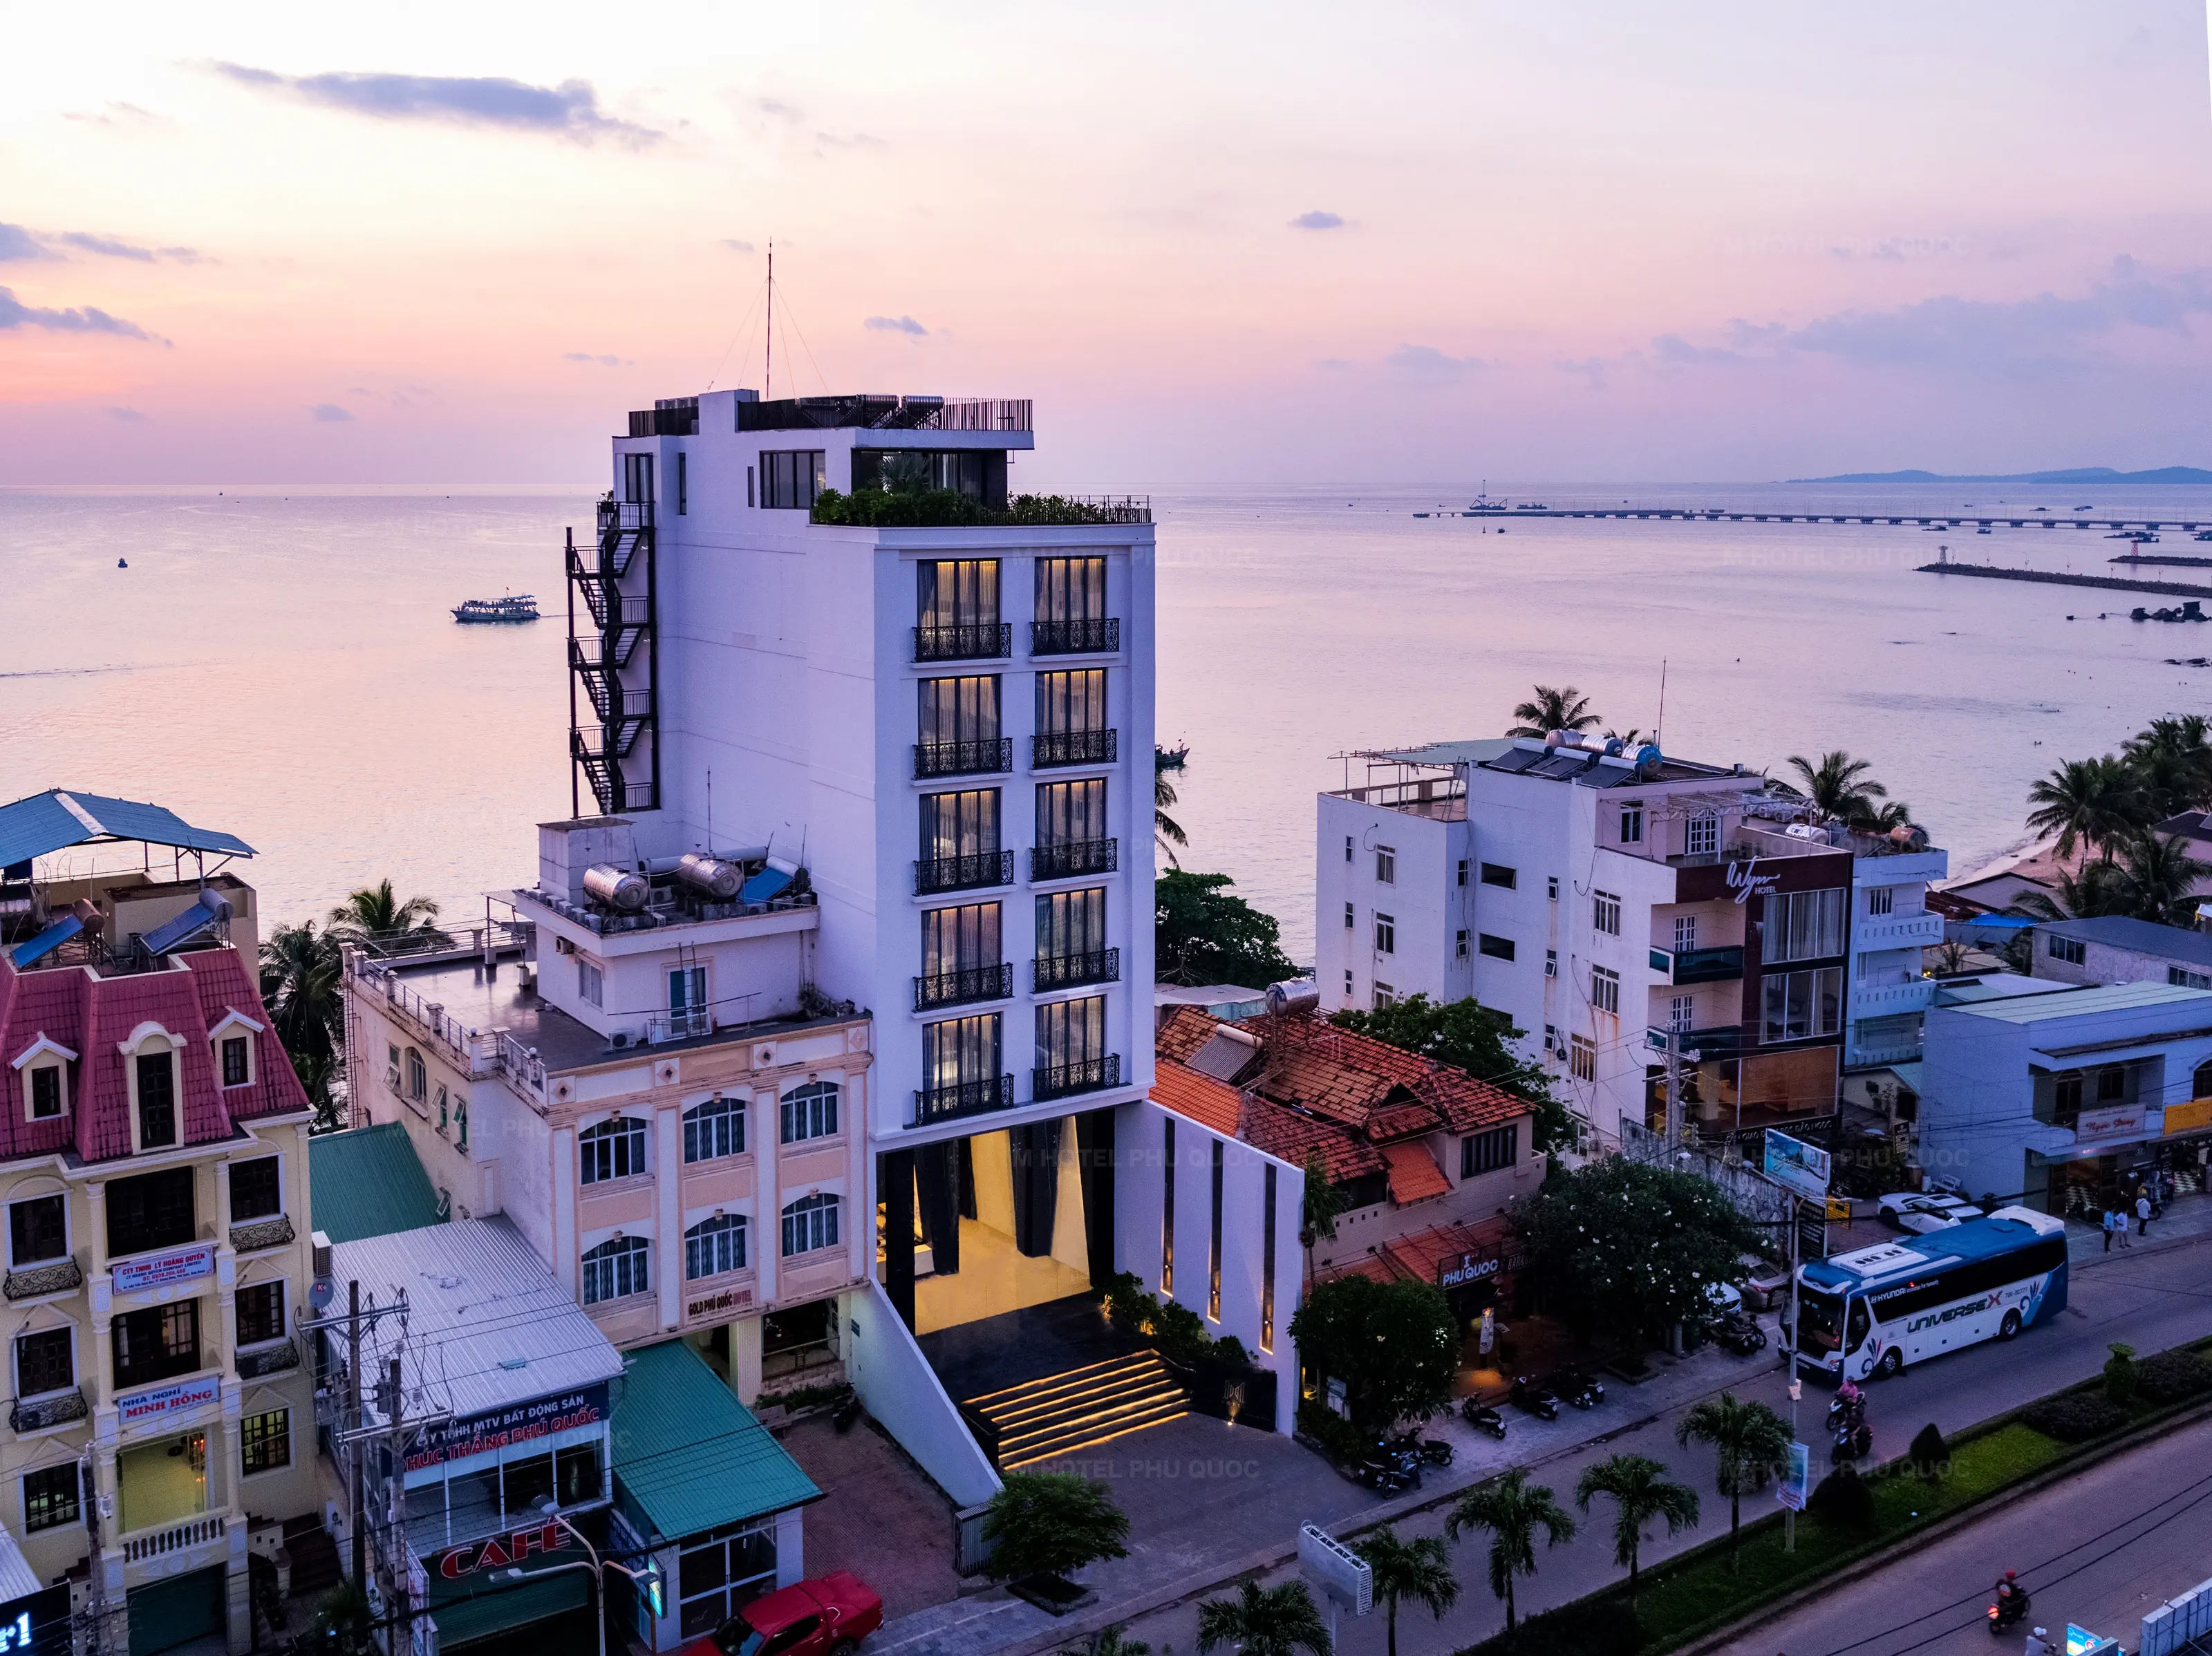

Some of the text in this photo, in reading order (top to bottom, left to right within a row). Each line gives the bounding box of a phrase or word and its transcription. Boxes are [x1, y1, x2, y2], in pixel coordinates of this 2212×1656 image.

[1755, 886, 1776, 894] HOTEL
[1443, 1259, 1499, 1286] PHU QUOC
[1877, 1288, 1906, 1301] HYUNDAI
[688, 1301, 704, 1316] GOLD
[126, 1401, 166, 1418] MINH
[474, 1418, 500, 1433] MTV
[503, 1407, 525, 1425] BẤT
[528, 1402, 559, 1419] ĐỘNG
[561, 1394, 585, 1409] SẢN
[447, 1432, 509, 1462] THẮNG
[550, 1403, 600, 1431] QUỐC
[441, 1515, 571, 1579] CAFÉ
